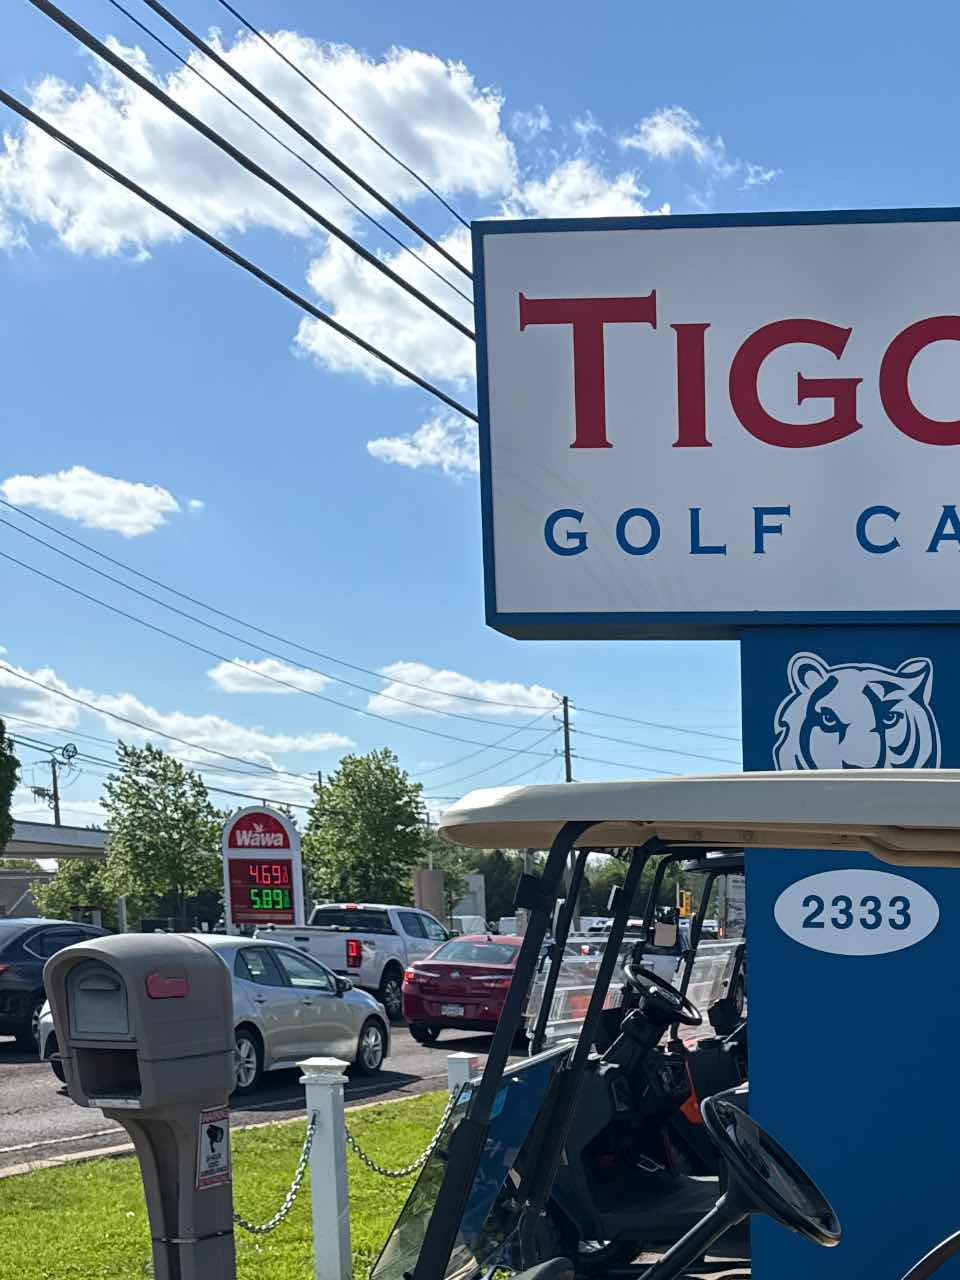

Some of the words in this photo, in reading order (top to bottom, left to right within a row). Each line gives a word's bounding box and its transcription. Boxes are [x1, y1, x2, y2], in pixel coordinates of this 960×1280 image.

[544, 504, 791, 557] GOLF
[235, 830, 284, 847] Wawa
[802, 895, 911, 930] 2333
